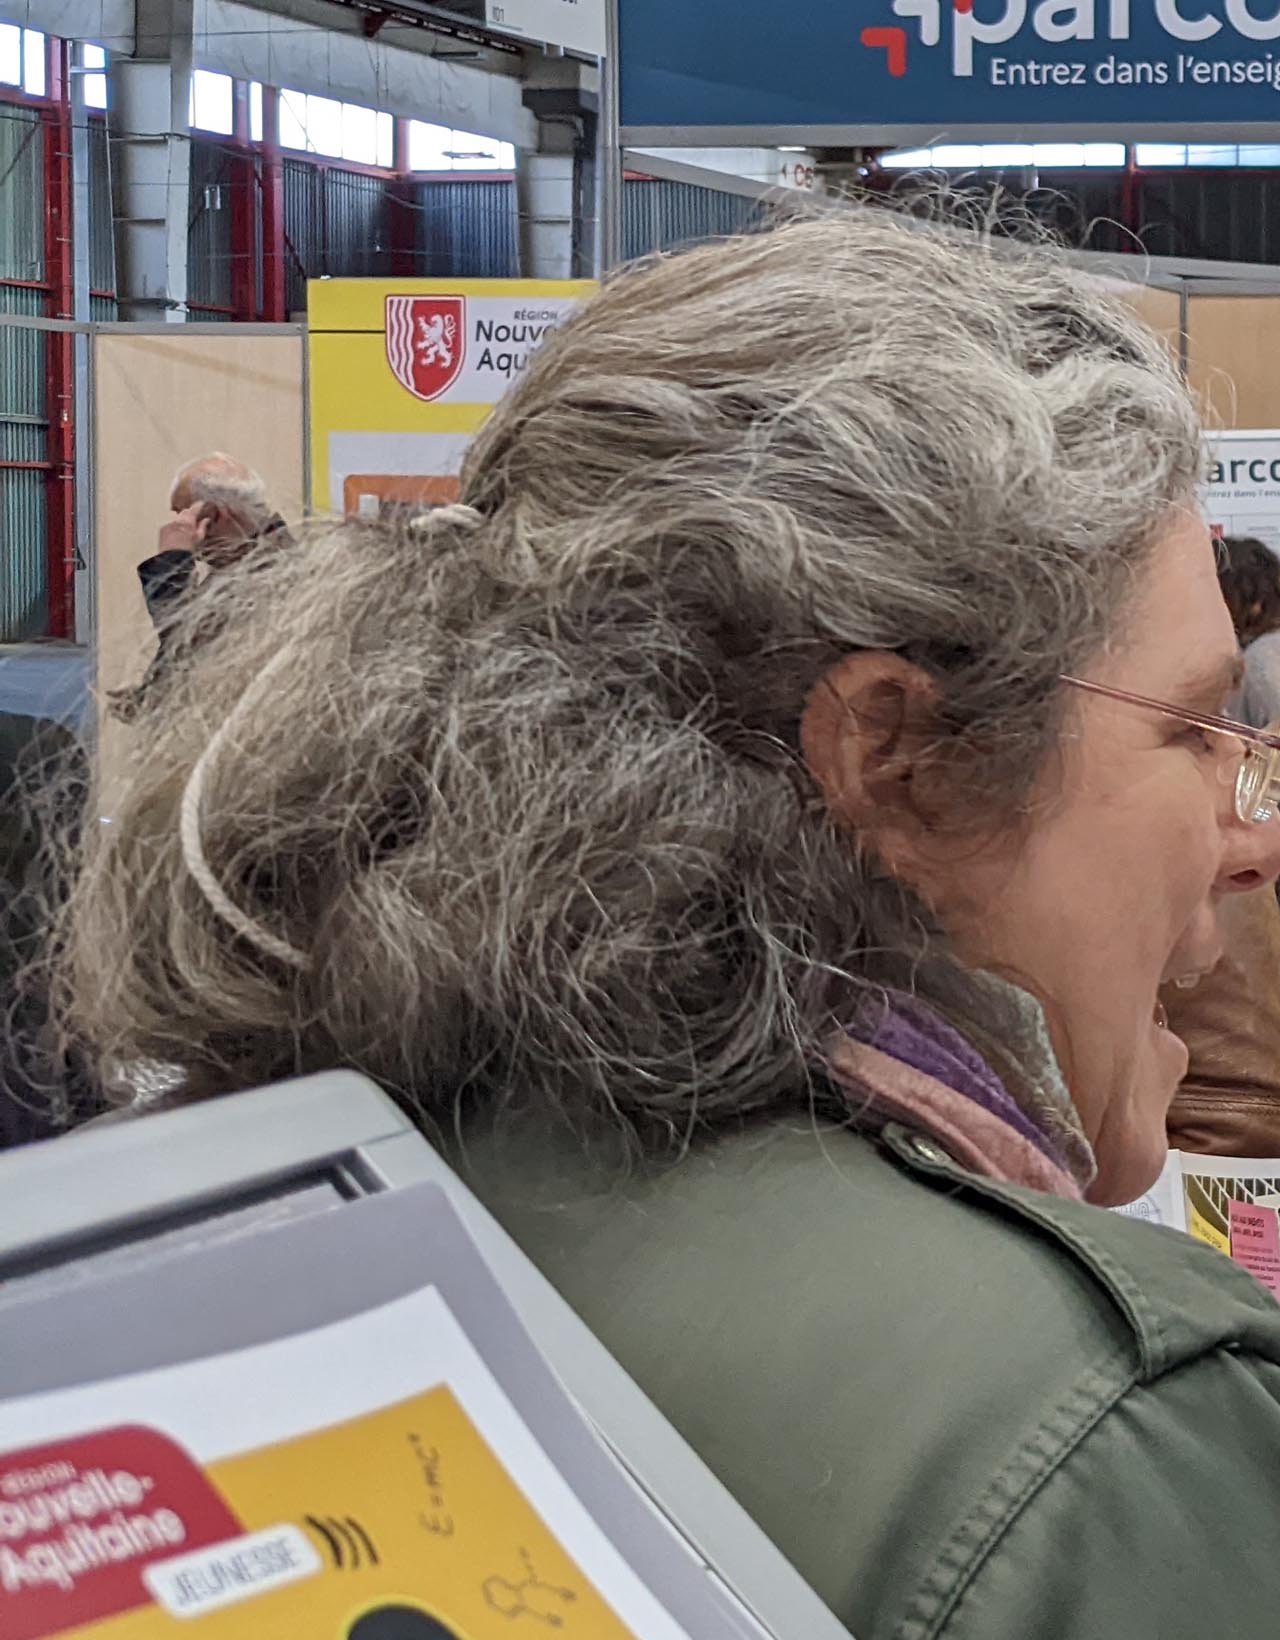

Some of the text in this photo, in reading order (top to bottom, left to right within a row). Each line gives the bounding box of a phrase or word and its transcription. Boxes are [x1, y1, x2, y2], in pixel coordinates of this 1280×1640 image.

[990, 58, 1086, 85] Entrez
[1094, 55, 1168, 84] dans
[513, 308, 557, 320] RÉGION
[475, 320, 554, 342] Nouv
[0, 1507, 187, 1593] Aquitaine
[176, 1538, 298, 1606] JEUNESSE
